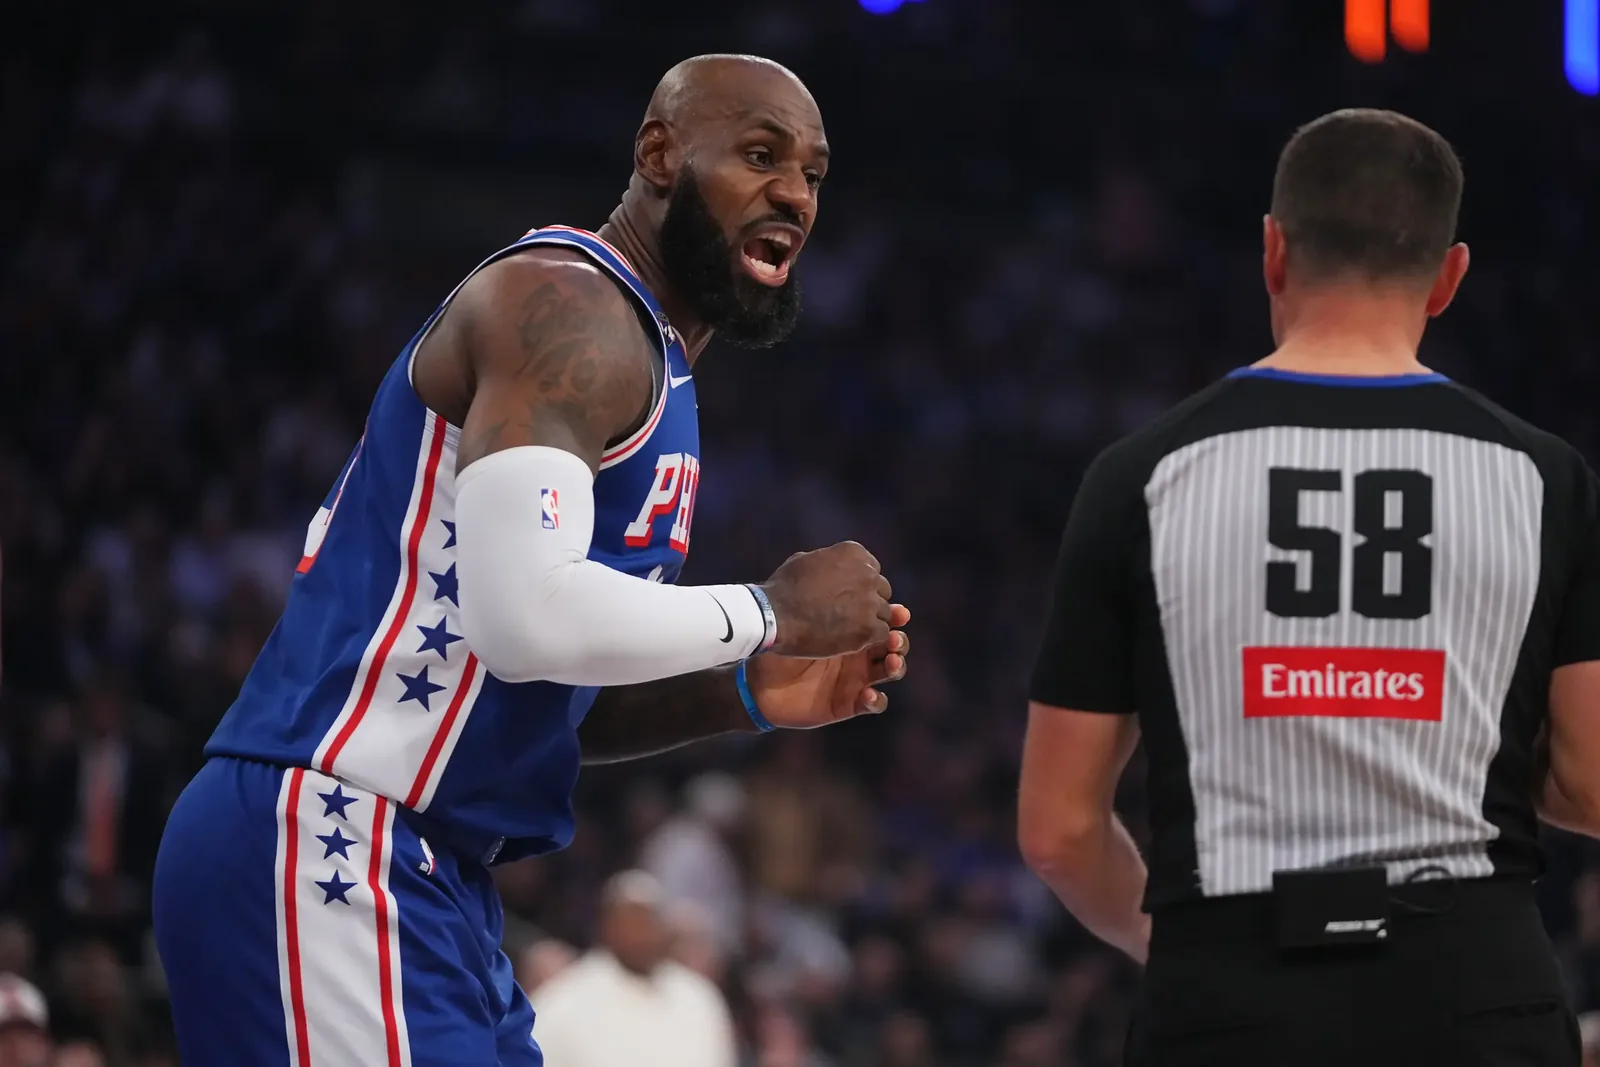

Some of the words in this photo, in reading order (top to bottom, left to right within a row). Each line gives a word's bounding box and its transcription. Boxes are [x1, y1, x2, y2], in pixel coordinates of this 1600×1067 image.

[624, 452, 700, 557] PH
[1265, 466, 1433, 619] 58
[1262, 662, 1425, 702] Emirates
